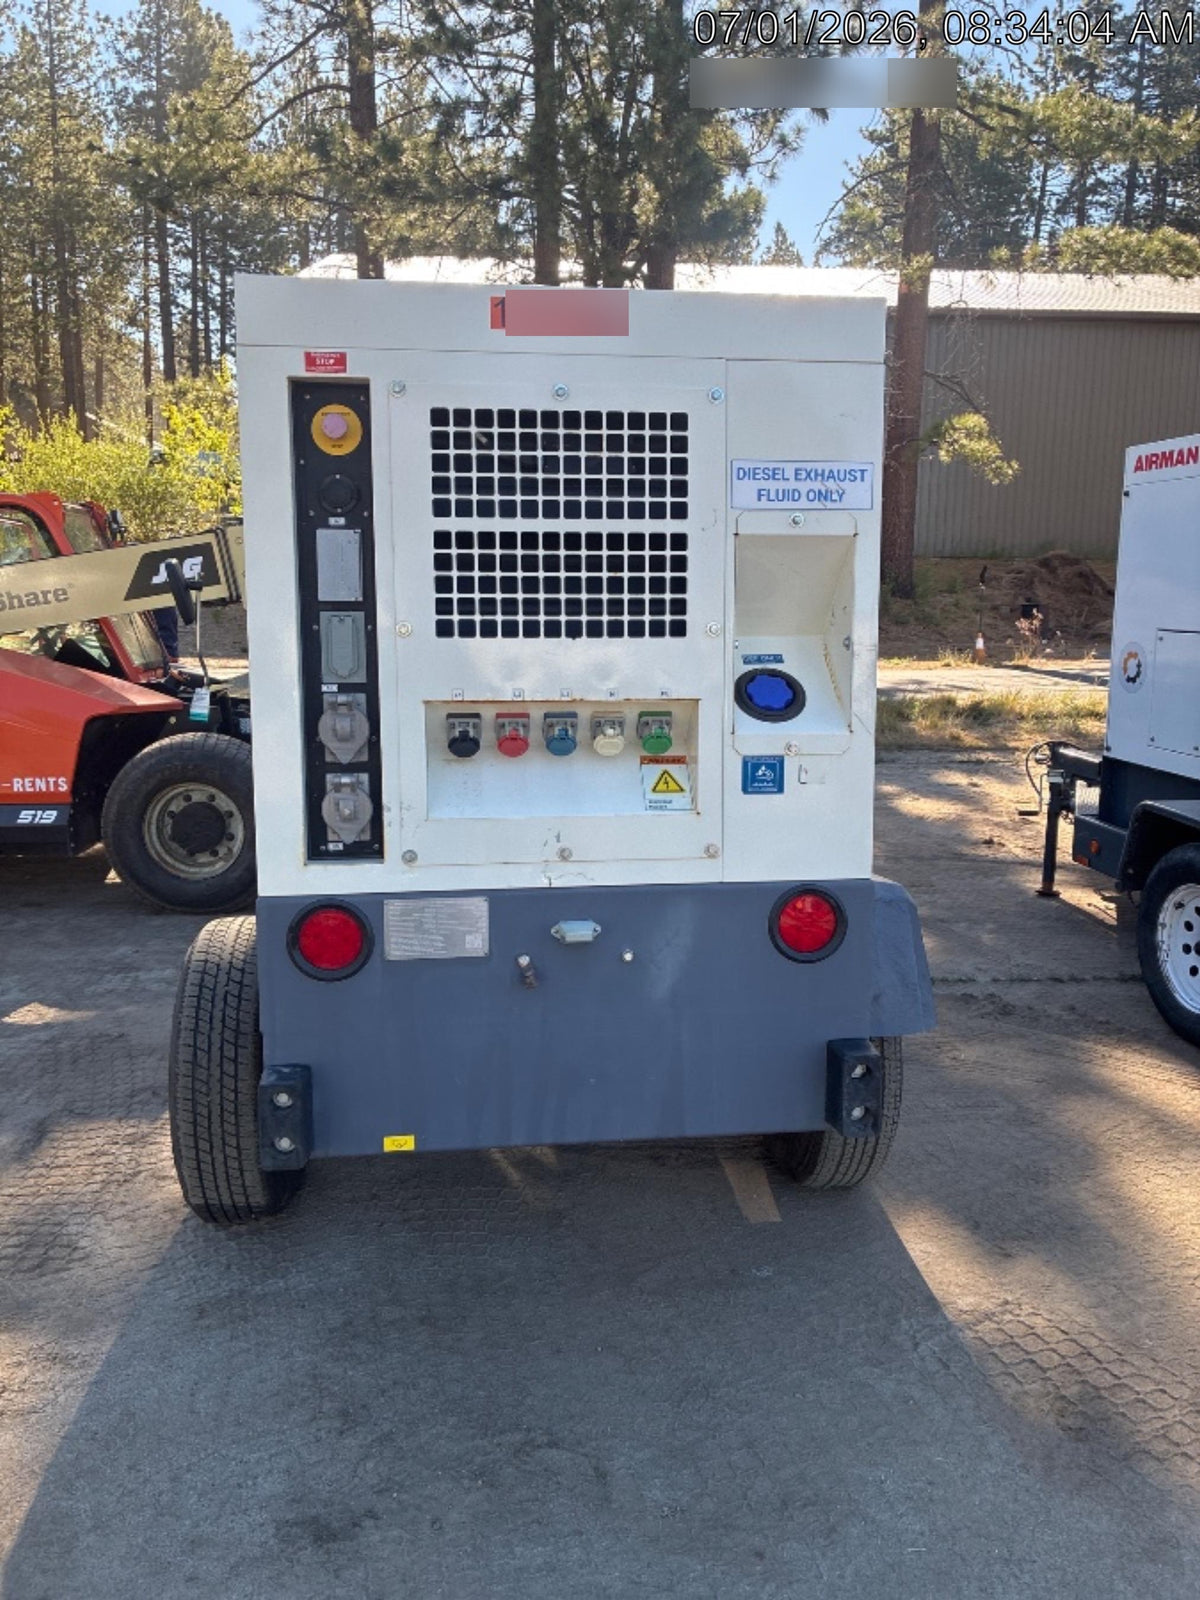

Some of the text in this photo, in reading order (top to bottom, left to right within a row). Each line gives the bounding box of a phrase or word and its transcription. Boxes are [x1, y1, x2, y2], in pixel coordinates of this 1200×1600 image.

[1134, 446, 1200, 473] AIRMAN
[736, 467, 869, 482] DIESEL EXHAUST
[757, 488, 846, 503] FLUID ONLY
[151, 556, 203, 584] JG
[13, 777, 68, 792] RENTS
[17, 810, 58, 824] 519
